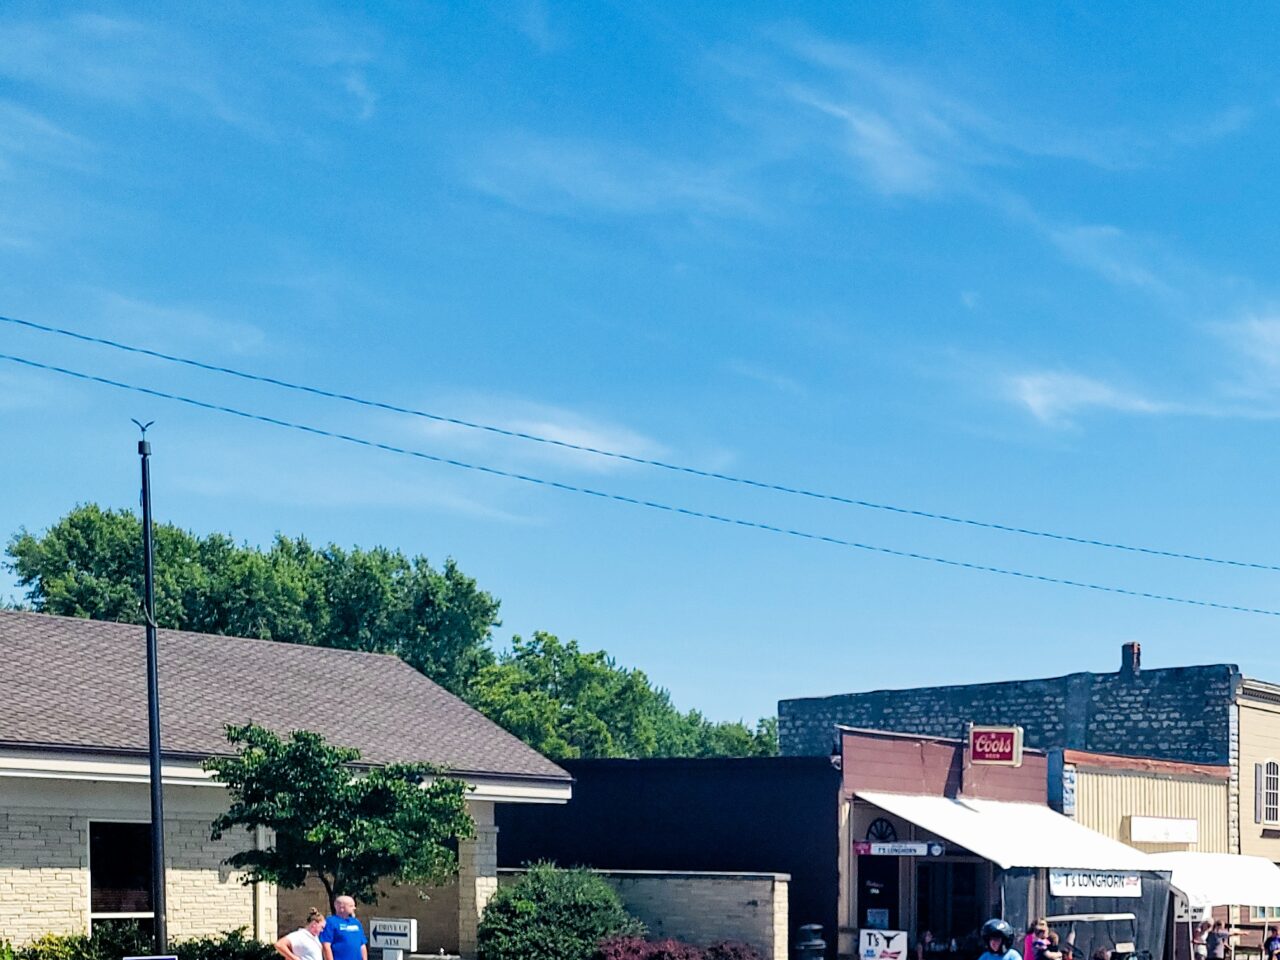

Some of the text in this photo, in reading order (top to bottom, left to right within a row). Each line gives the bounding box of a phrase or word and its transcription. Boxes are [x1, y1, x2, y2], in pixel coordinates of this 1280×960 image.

[975, 734, 1012, 753] Coors
[1078, 873, 1125, 888] LONGHORN
[385, 938, 400, 946] ATM
